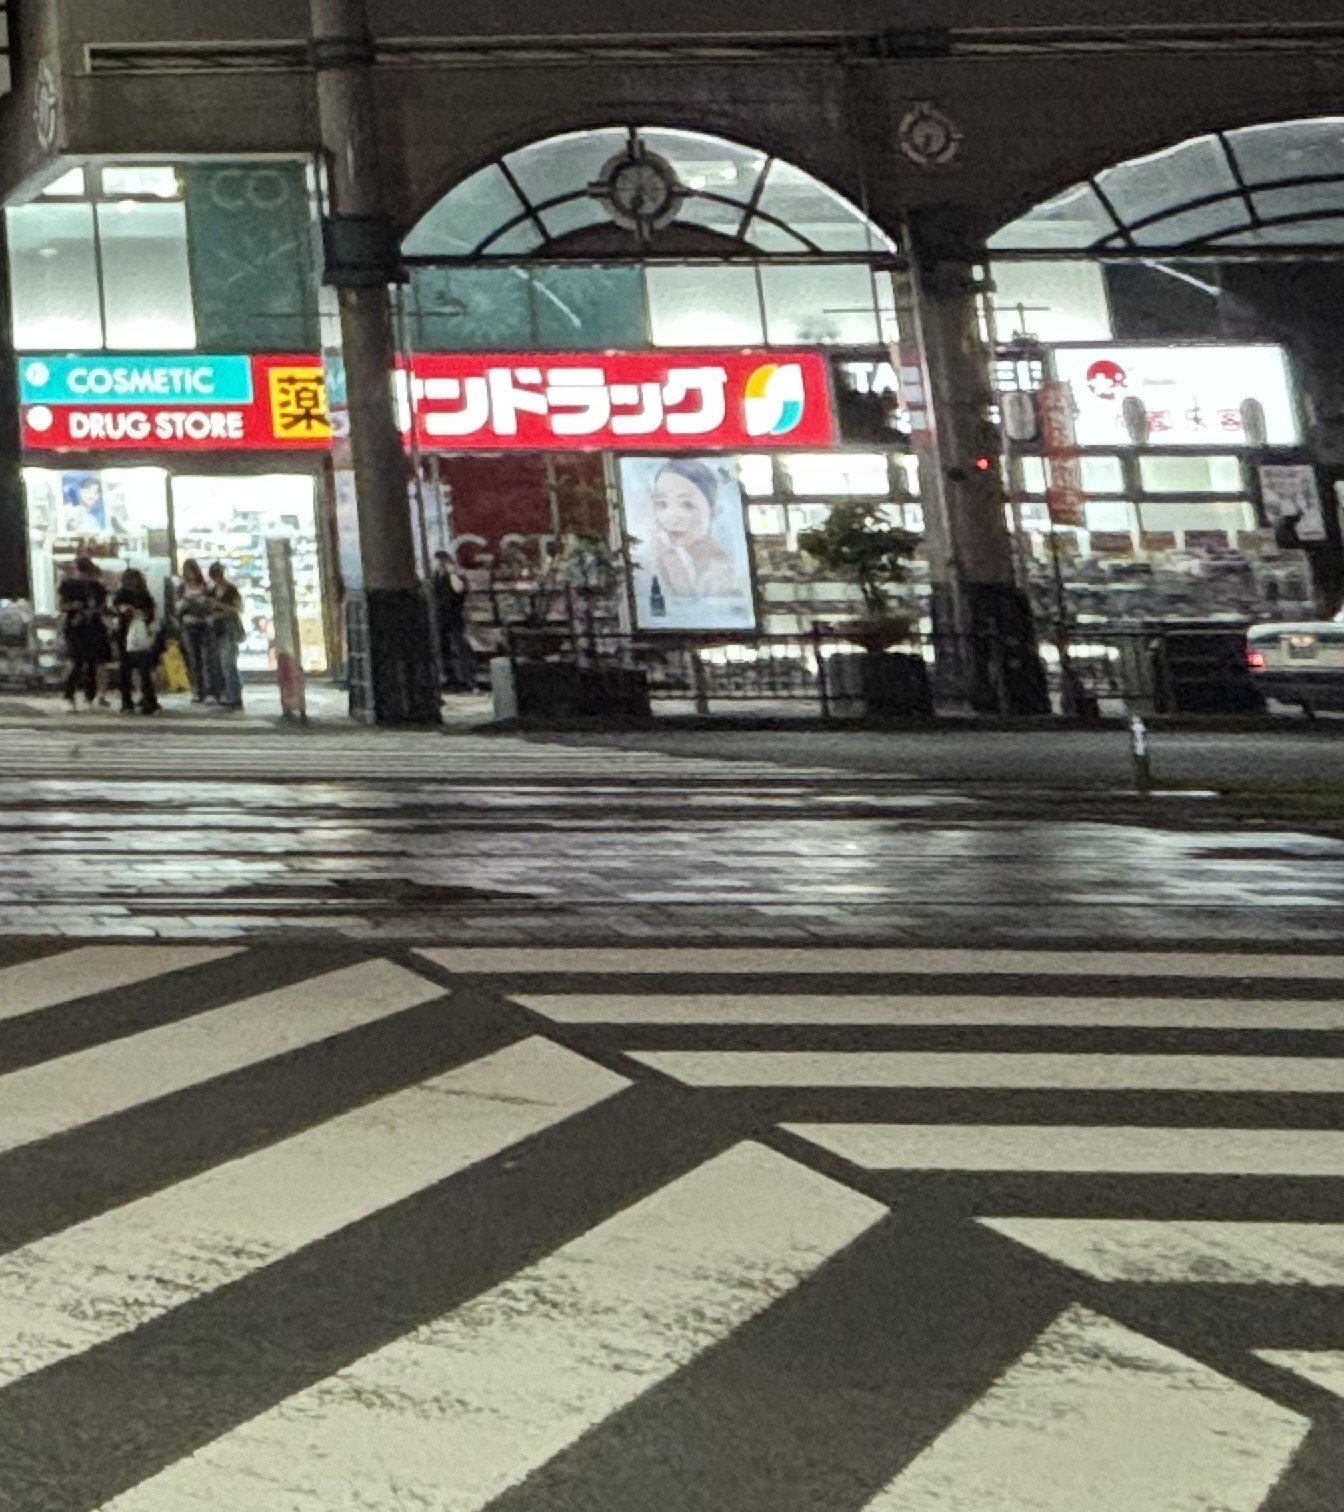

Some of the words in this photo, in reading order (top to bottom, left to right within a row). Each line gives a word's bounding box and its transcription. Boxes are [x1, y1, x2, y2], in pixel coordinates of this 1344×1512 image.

[66, 367, 215, 395] COSMETIC
[276, 375, 331, 430] 薬
[68, 410, 152, 441] DRUG
[154, 411, 245, 440] STORE
